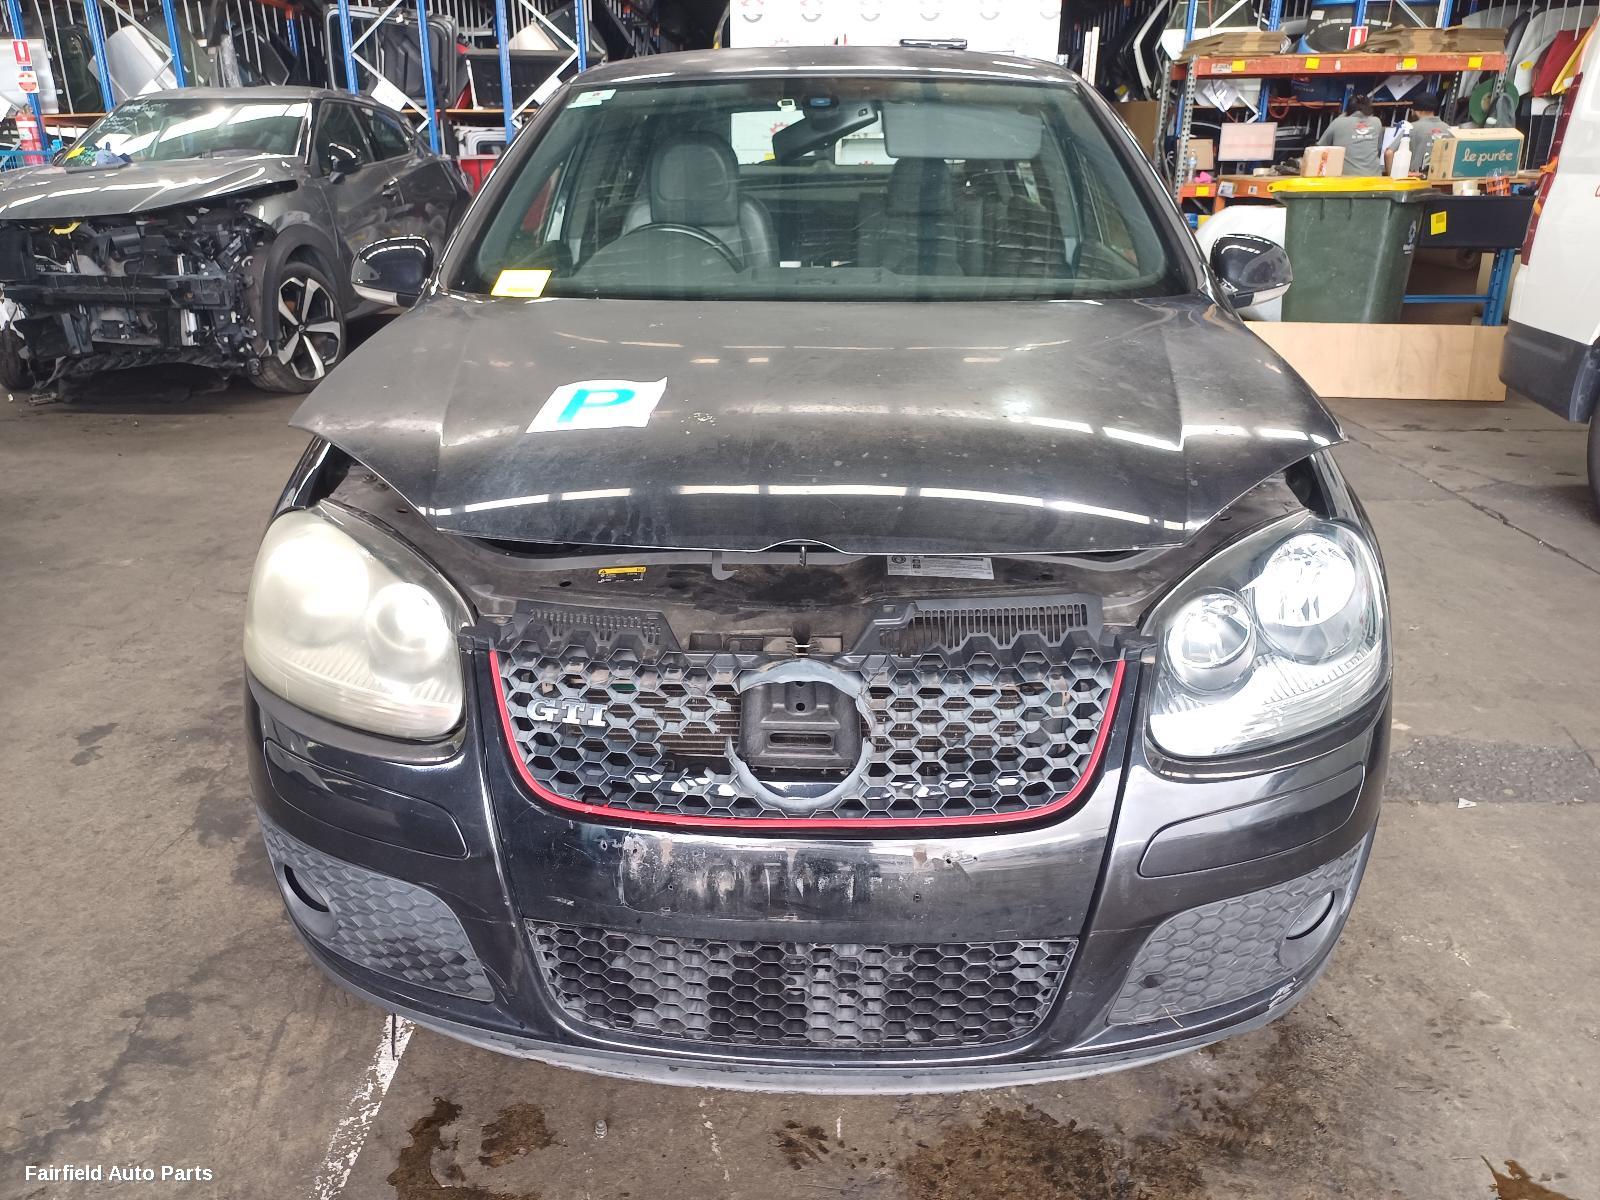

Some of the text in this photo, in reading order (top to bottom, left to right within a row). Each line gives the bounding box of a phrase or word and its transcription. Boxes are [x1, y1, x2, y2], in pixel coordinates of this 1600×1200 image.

[1462, 147, 1513, 167] le purée
[557, 388, 636, 424] P
[526, 699, 608, 727] GTI
